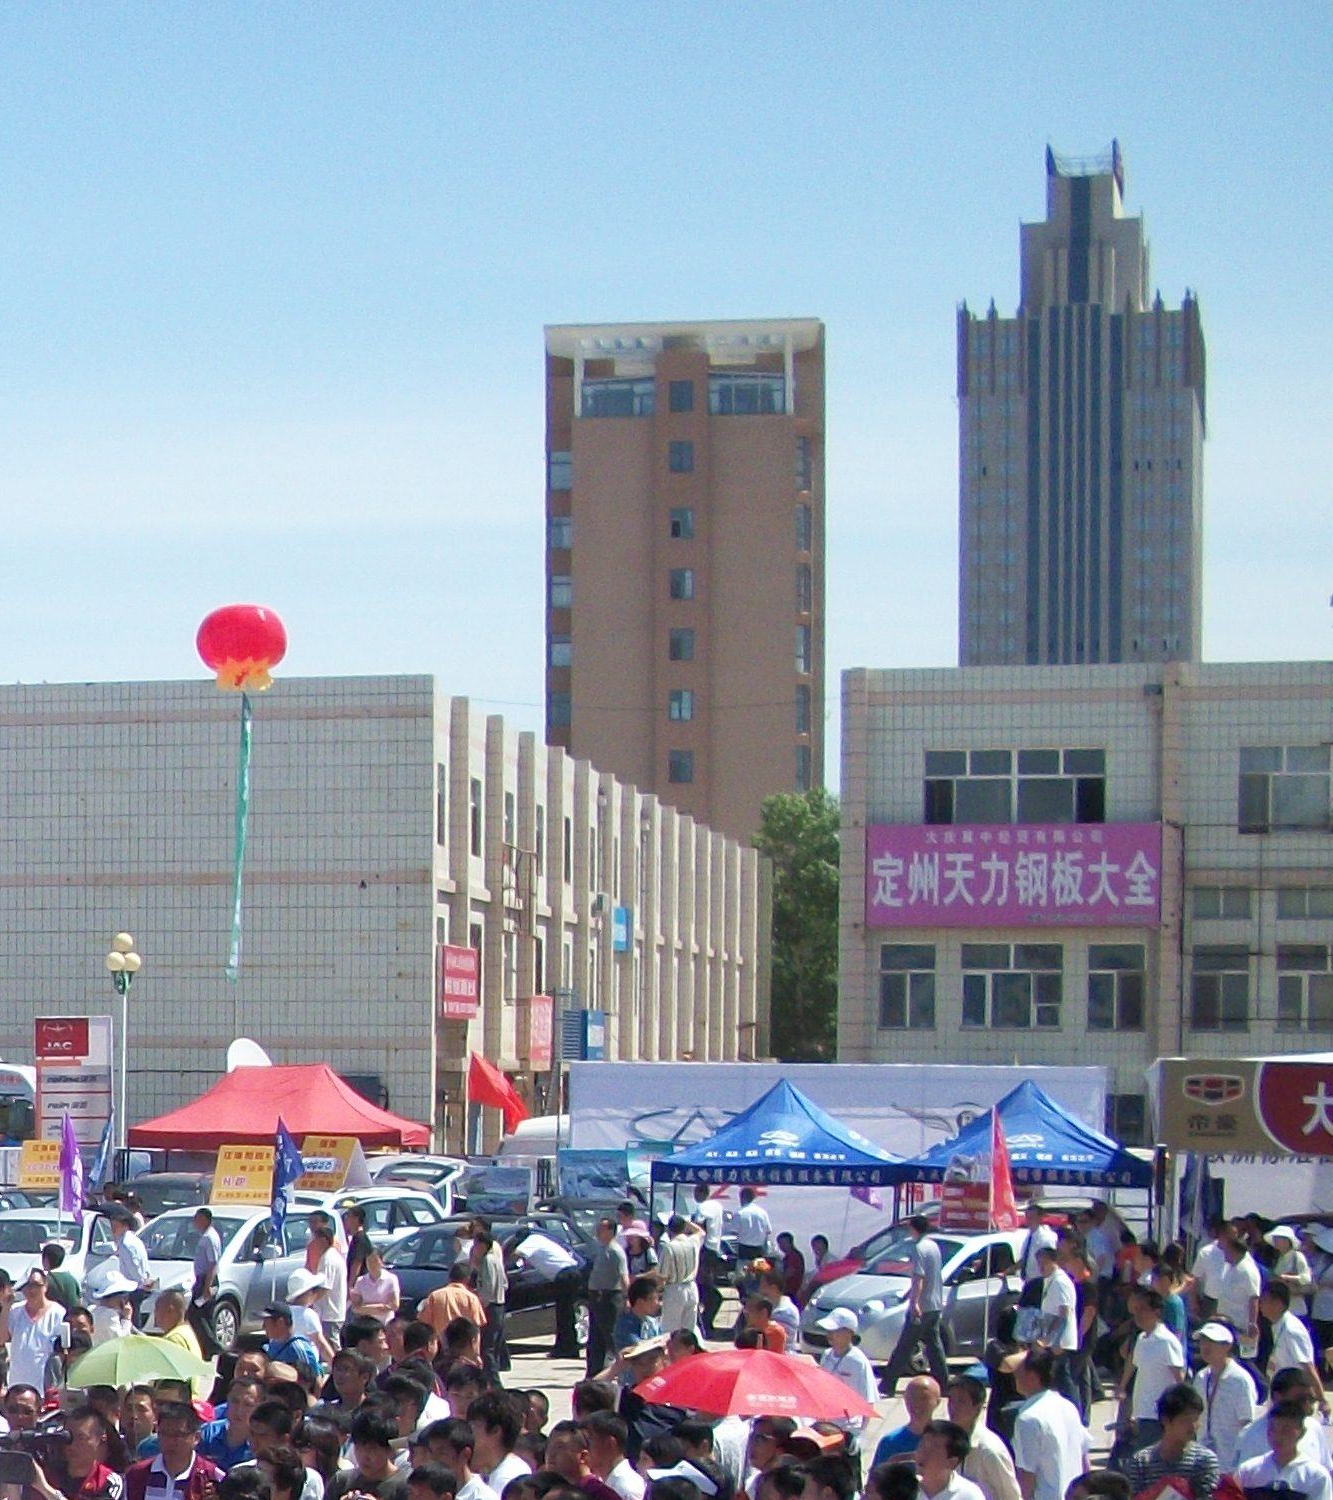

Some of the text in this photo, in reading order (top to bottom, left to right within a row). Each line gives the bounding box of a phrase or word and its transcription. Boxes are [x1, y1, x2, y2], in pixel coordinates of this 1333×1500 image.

[872, 850, 1157, 907] 定州天力钢板大全
